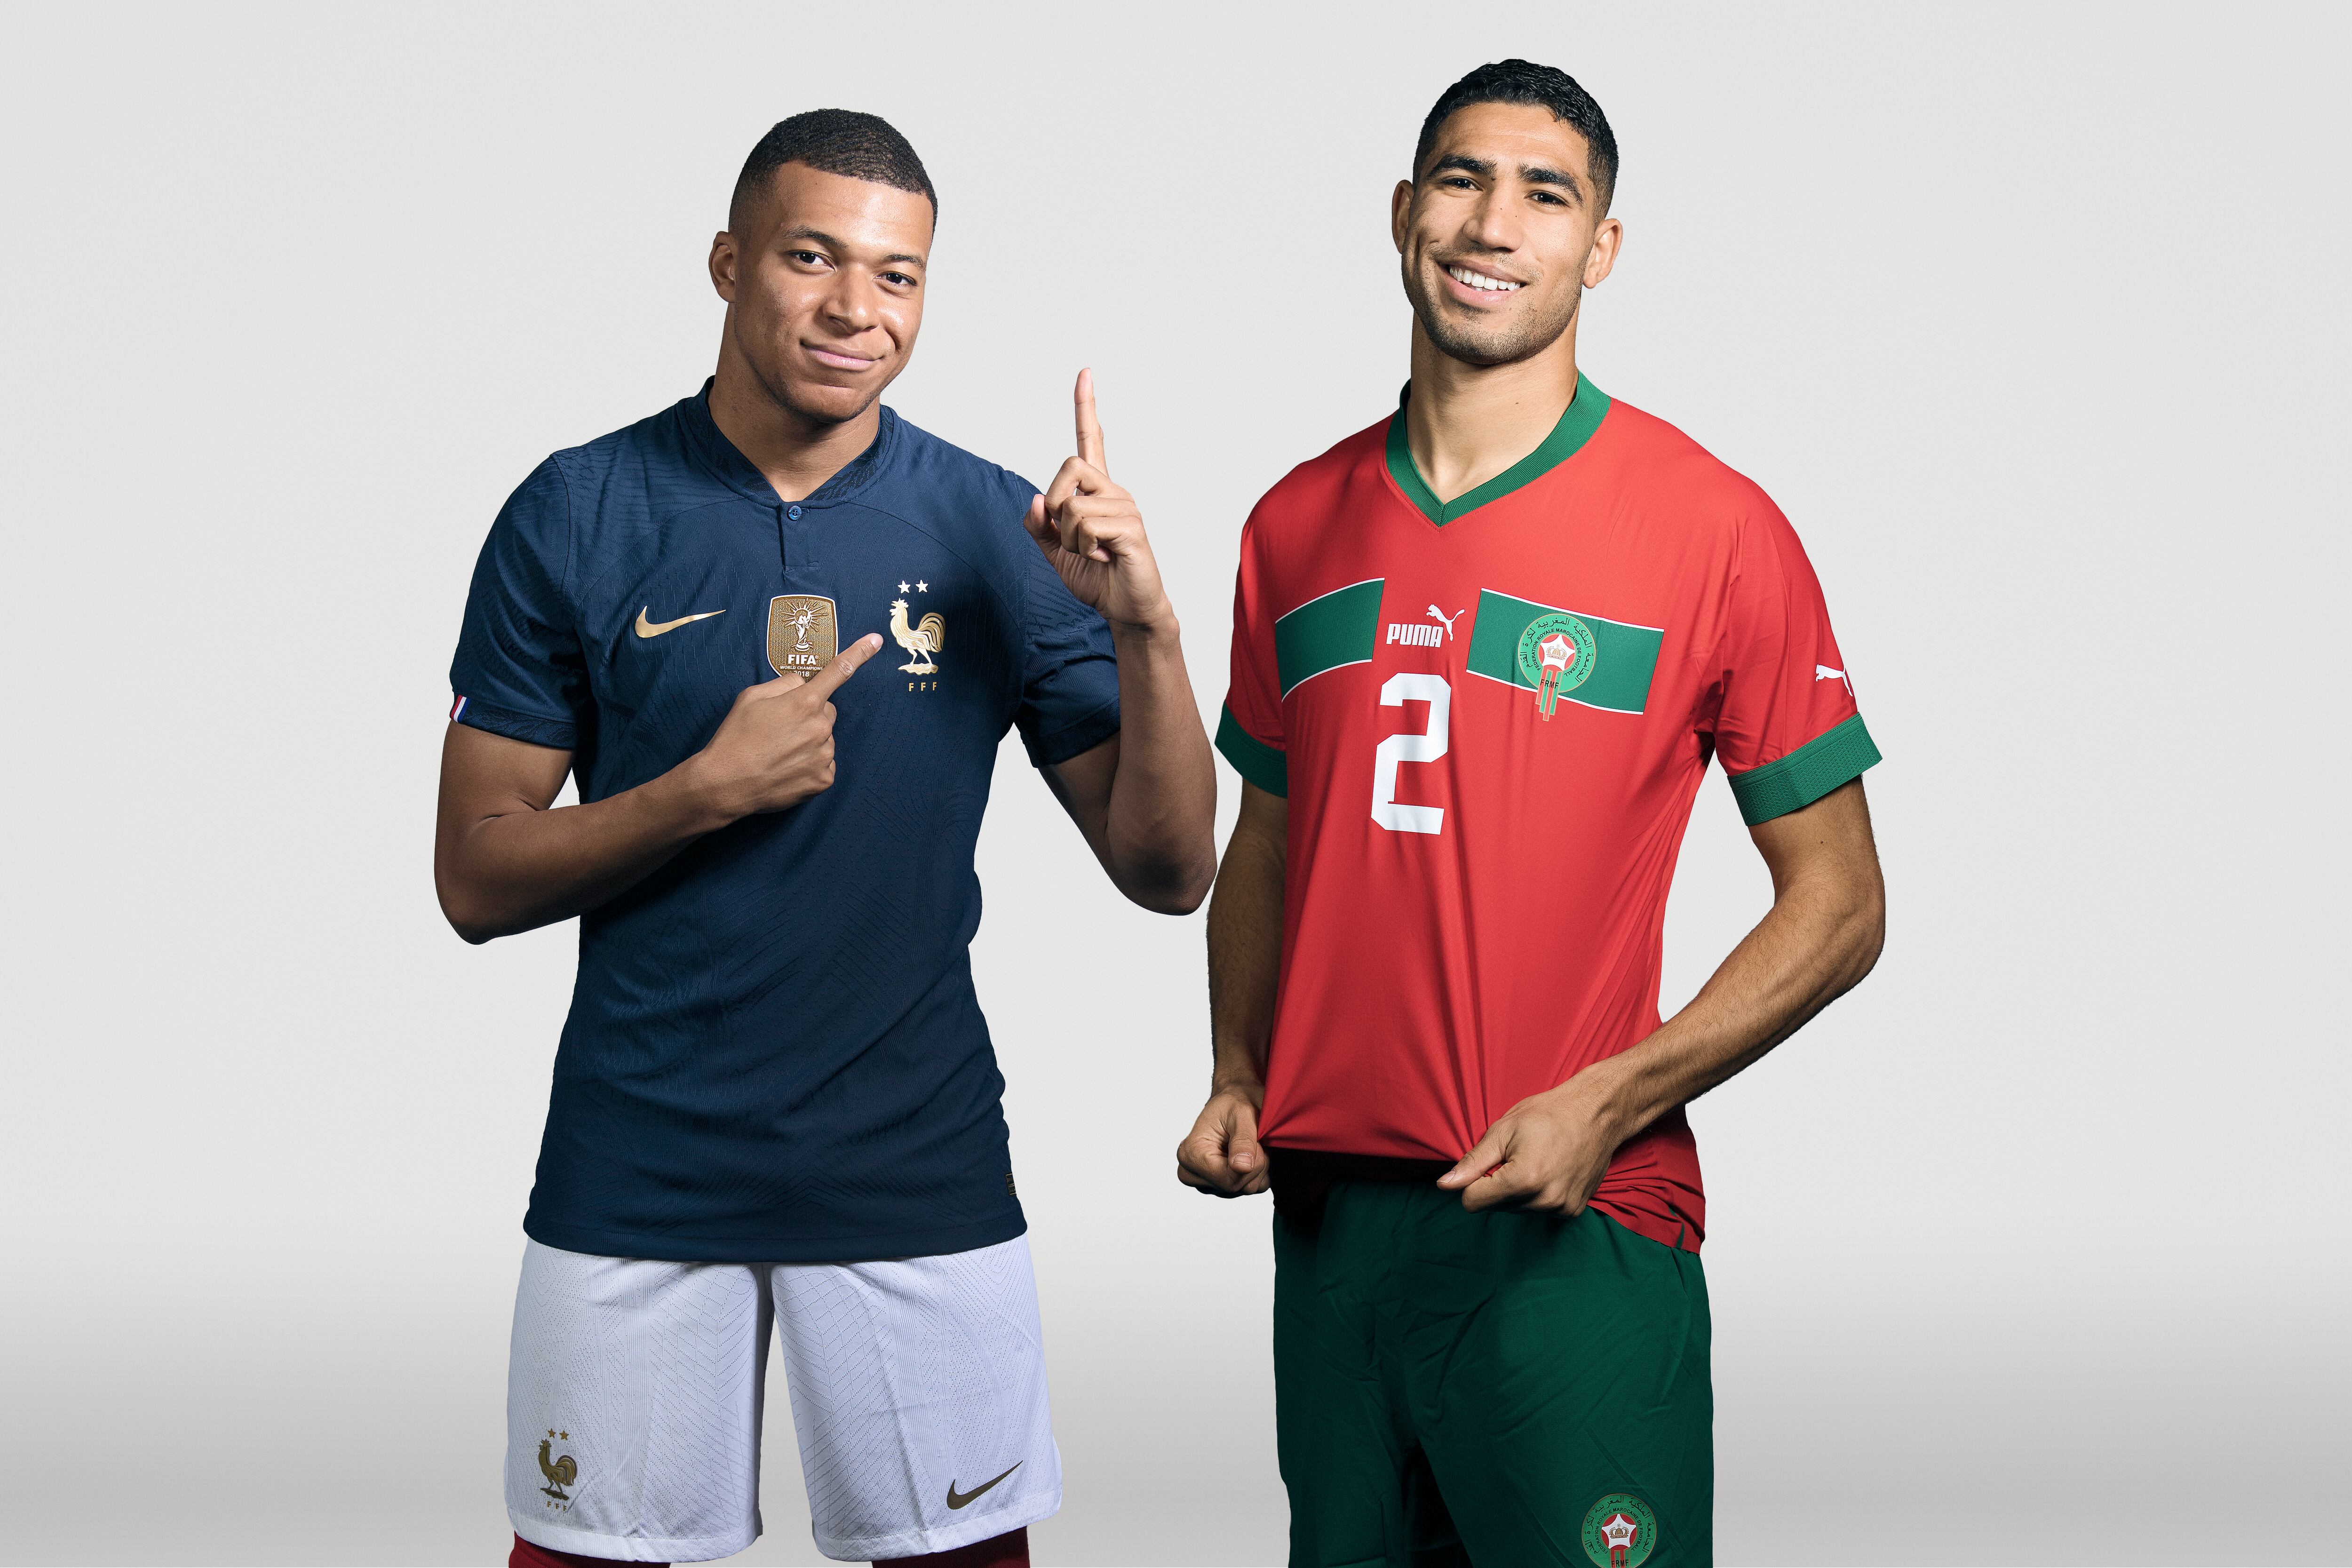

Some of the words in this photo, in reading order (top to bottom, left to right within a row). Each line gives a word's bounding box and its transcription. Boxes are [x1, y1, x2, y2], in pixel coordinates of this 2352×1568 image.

[1536, 617, 1570, 629] المغربية
[1386, 623, 1444, 648] PUMA
[1523, 628, 1535, 646] لكرة
[1537, 629, 1554, 640] ROYALE
[1556, 628, 1580, 646] MAROCAINE
[1573, 623, 1592, 647] الملكية
[1532, 640, 1541, 671] FEDERATION
[1564, 655, 1581, 677] FOOTBALL
[1540, 679, 1559, 689] FRMF
[1371, 672, 1452, 835] 2
[1593, 1496, 1624, 1513] المغربية
[1613, 1507, 1639, 1520] MAROCAINE
[1629, 1498, 1651, 1519] الملكية
[1585, 1515, 1594, 1534] لكرة
[1597, 1509, 1612, 1525] ROYALE
[1595, 1526, 1608, 1554] FEDERATION
[1631, 1528, 1643, 1551] FOOTBALL
[1611, 1559, 1629, 1568] FRMF
